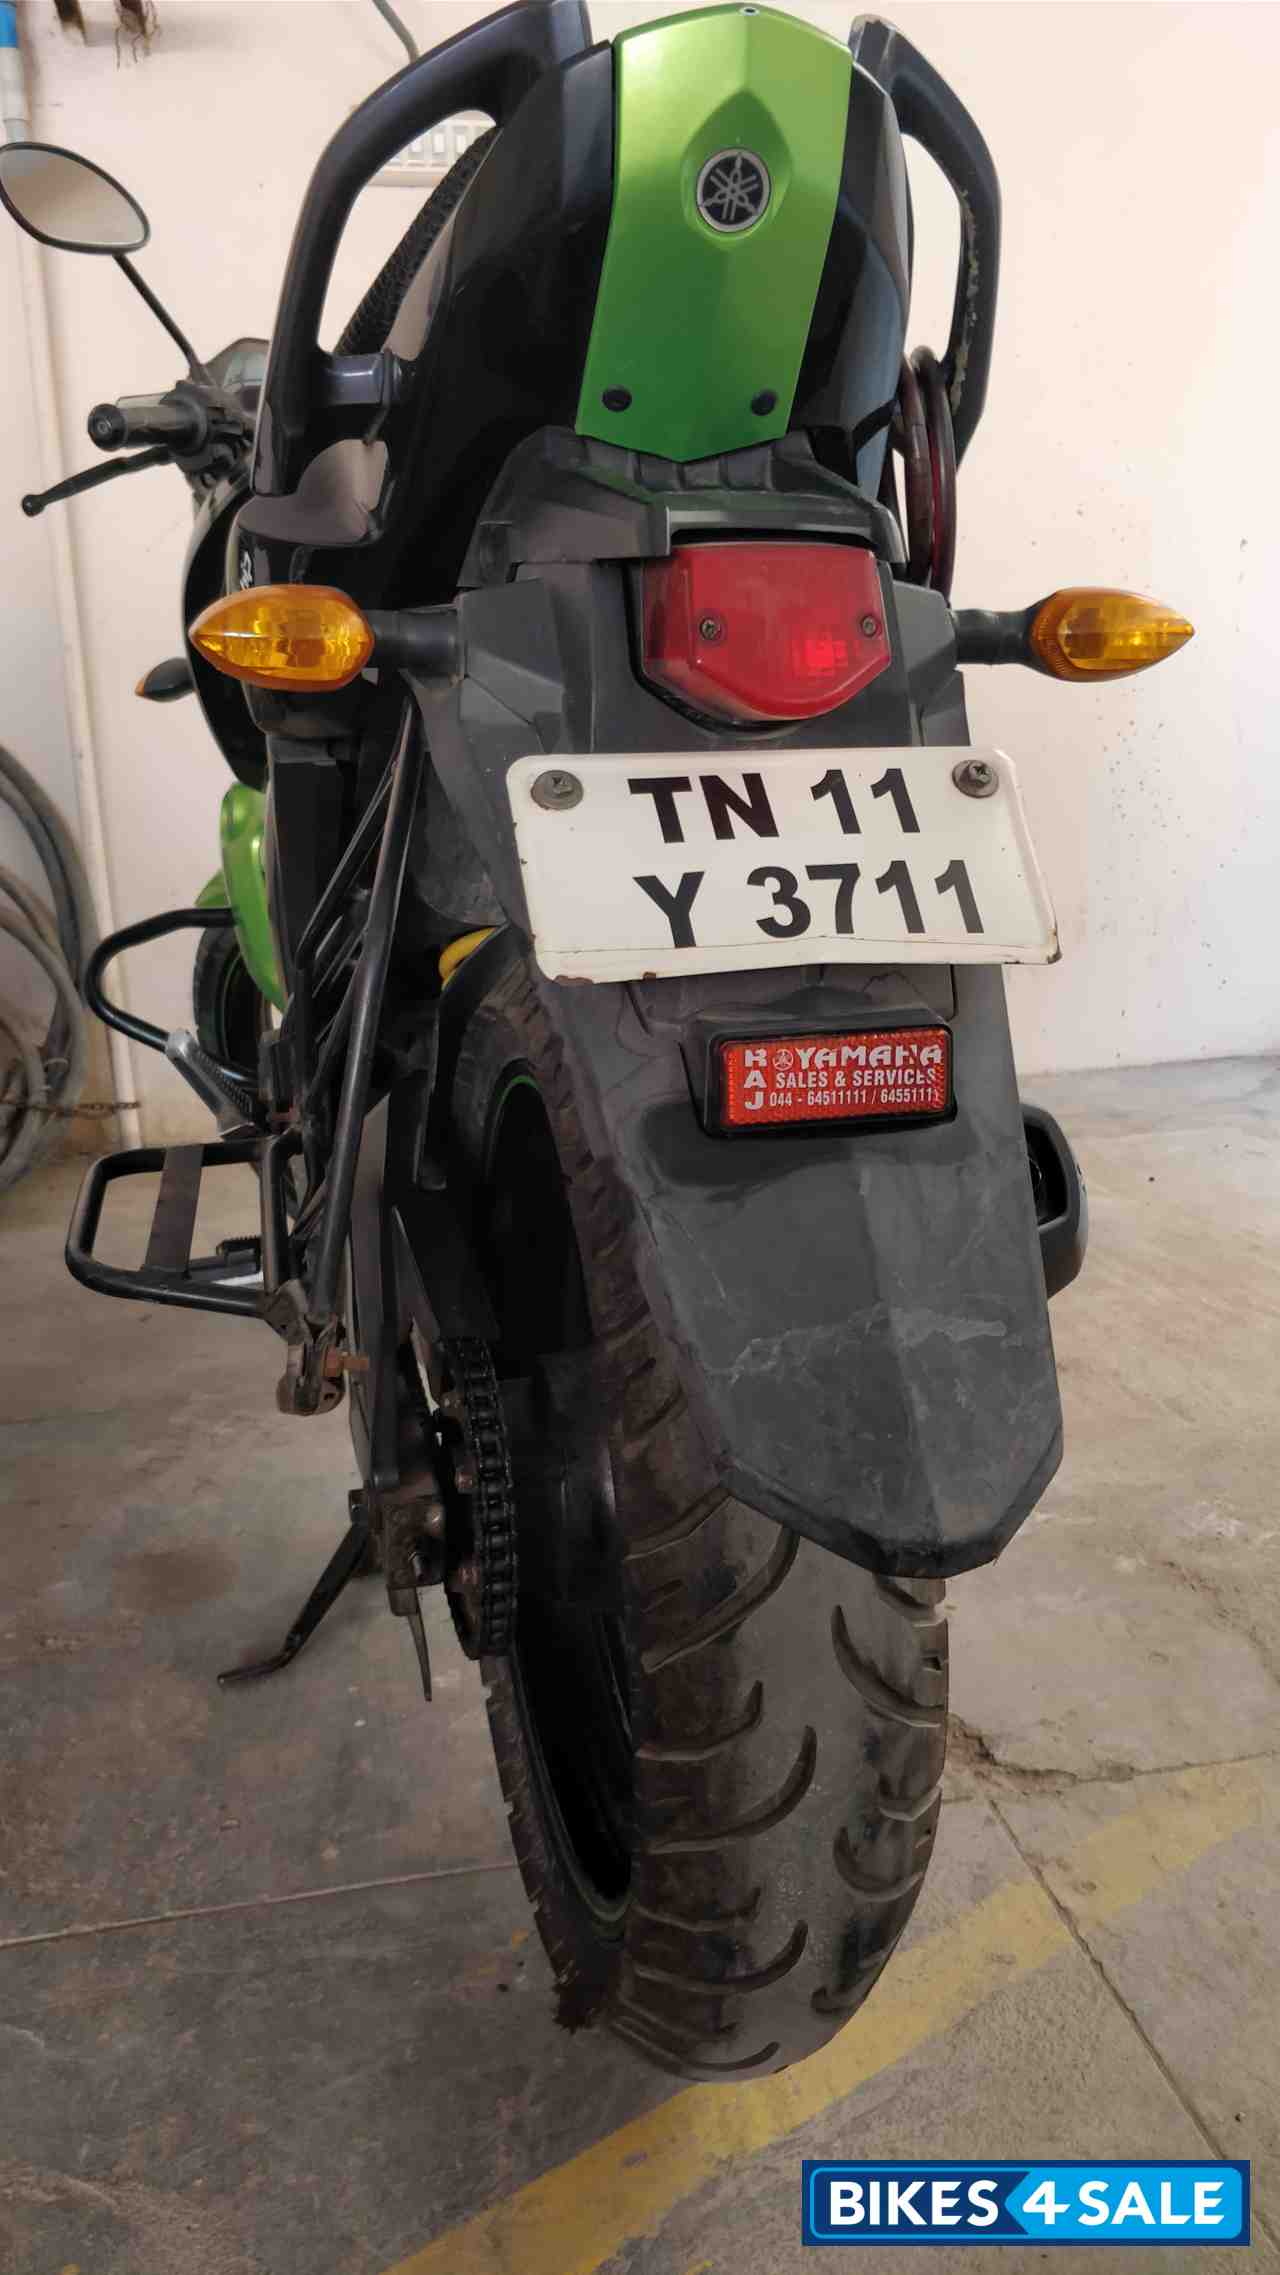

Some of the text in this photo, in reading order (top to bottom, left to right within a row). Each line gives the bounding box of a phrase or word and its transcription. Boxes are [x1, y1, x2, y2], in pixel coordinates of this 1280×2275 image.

[627, 767, 921, 844] TN 11
[632, 859, 985, 949] Y 3711
[795, 1044, 942, 1069] YAMAHA
[775, 1068, 937, 1089] SALES & SERVICES
[769, 1091, 793, 1107] 044
[807, 1089, 867, 1106] 64511111
